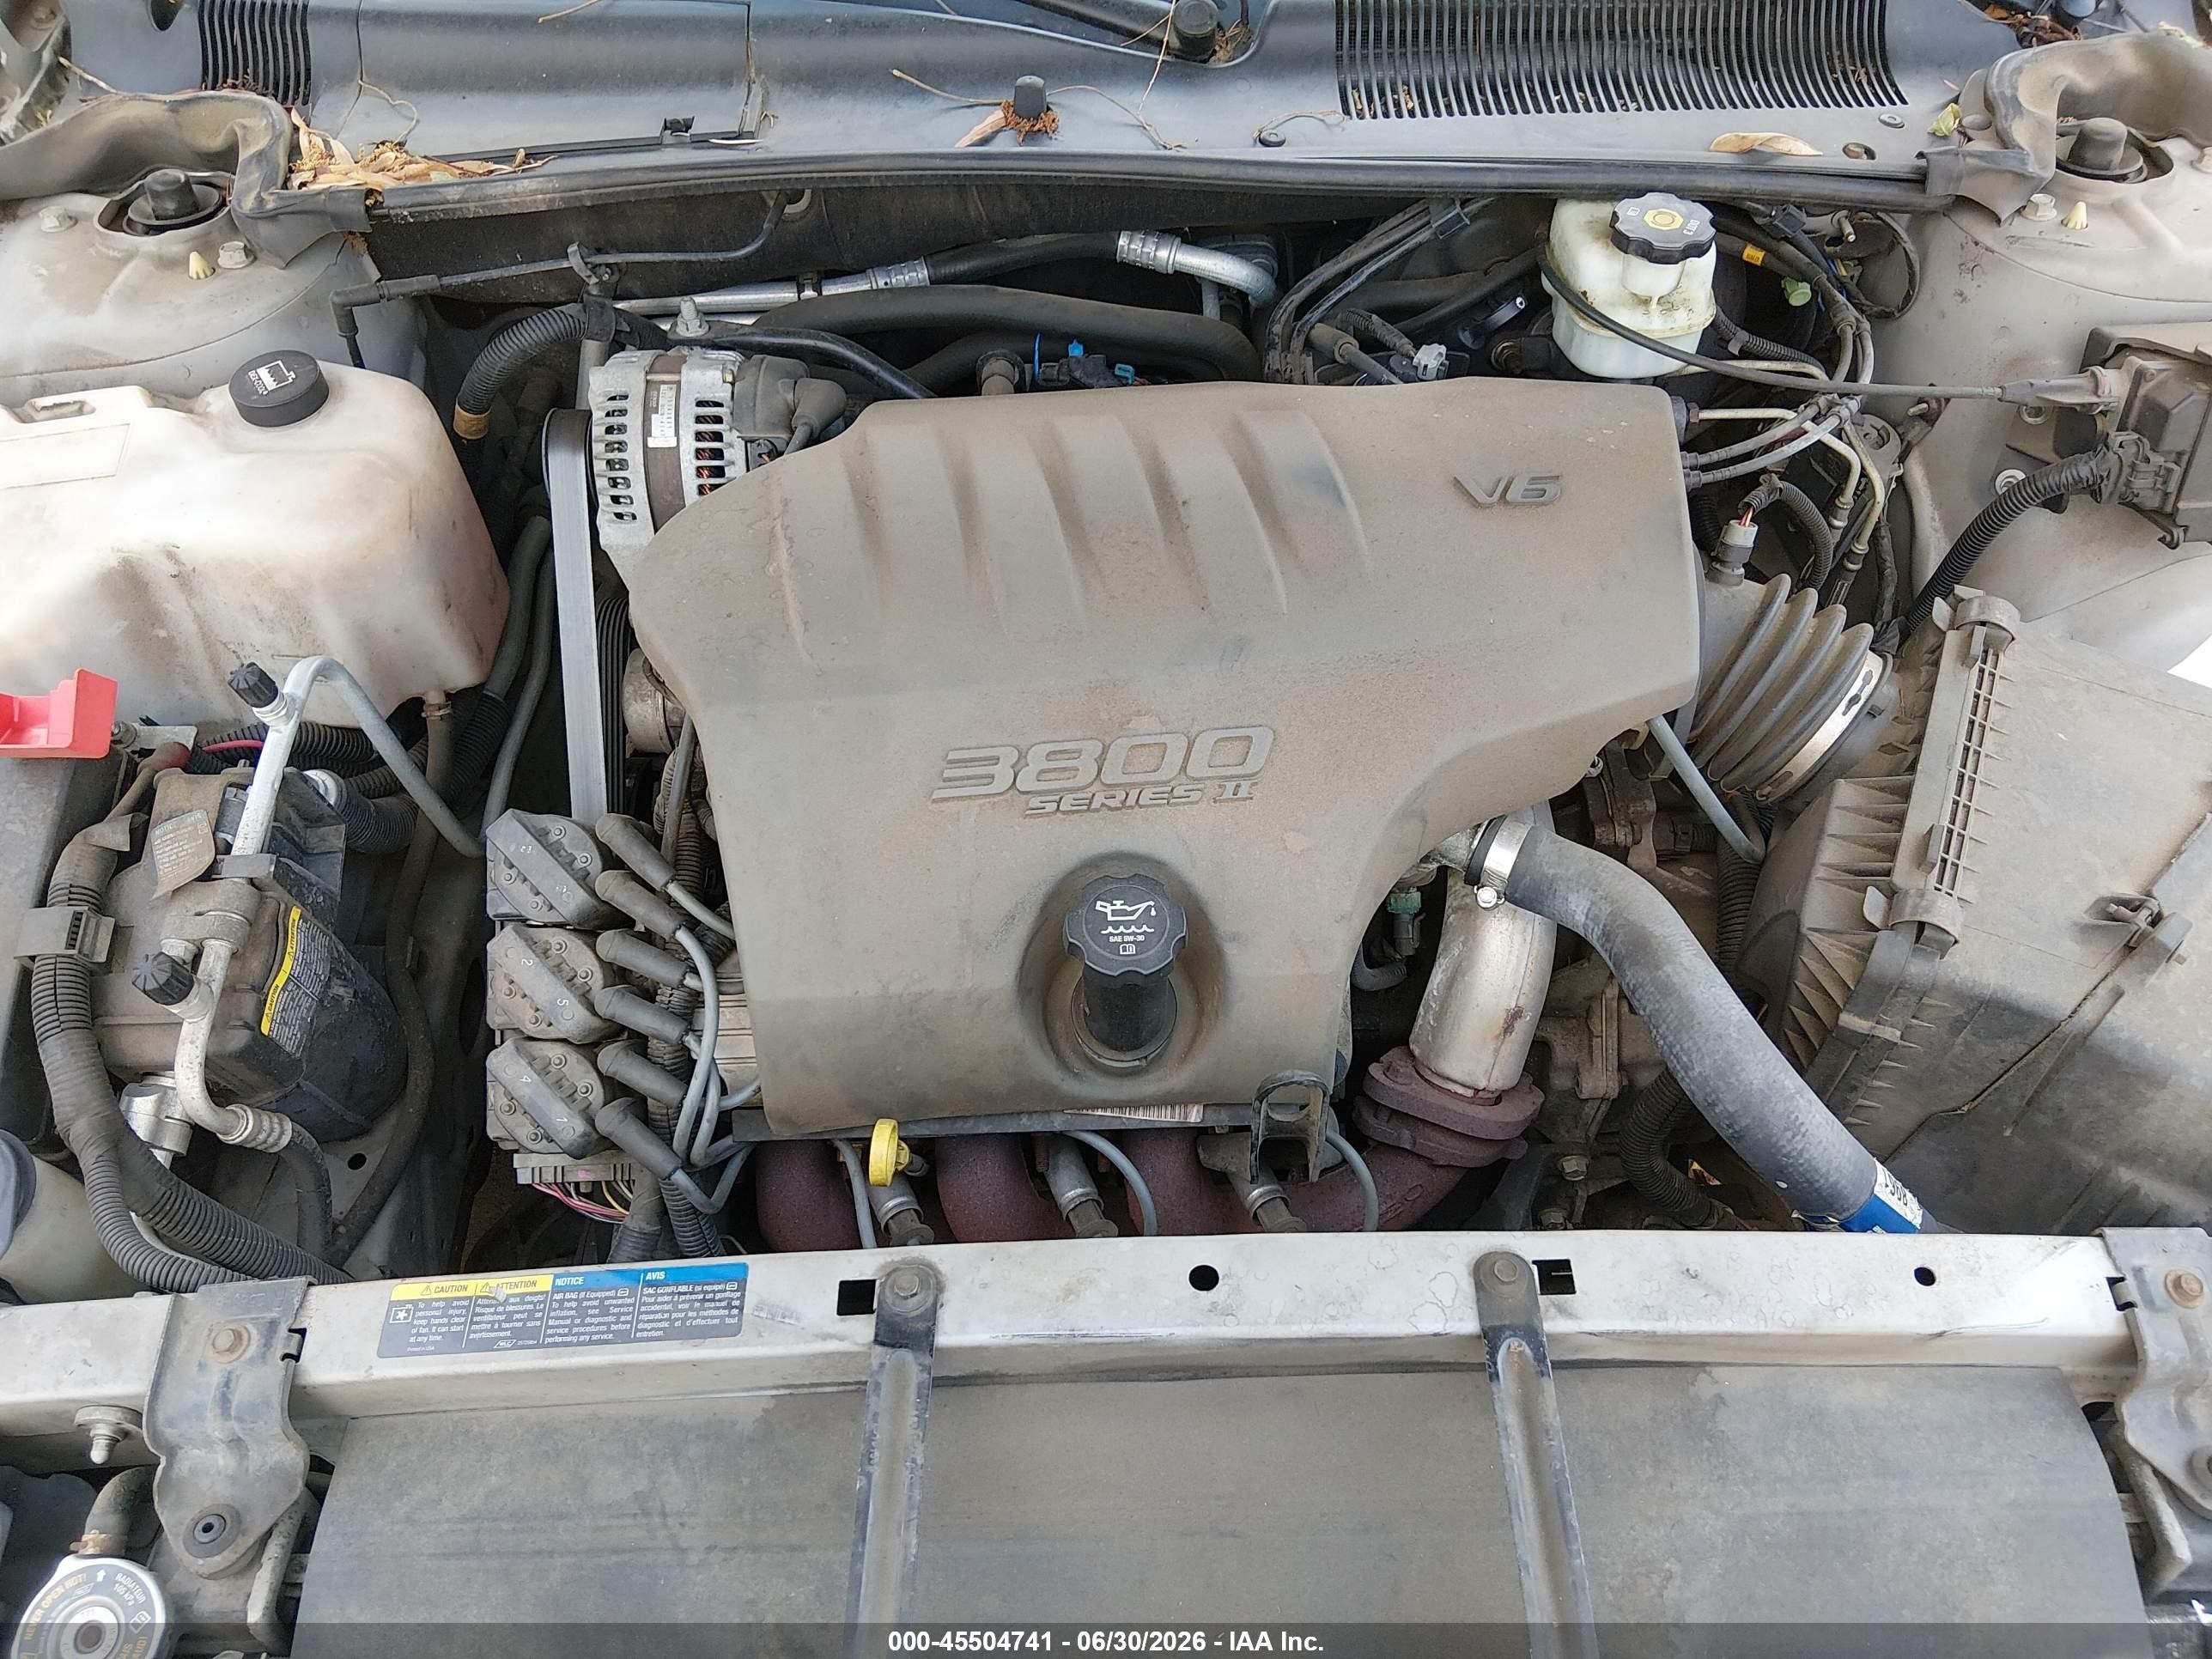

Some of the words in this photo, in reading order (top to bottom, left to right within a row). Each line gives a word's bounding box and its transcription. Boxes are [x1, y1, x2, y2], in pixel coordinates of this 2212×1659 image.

[1453, 474, 1562, 506] V6
[932, 726, 1274, 802] 3800
[1024, 784, 1204, 818] SERIES
[1123, 934, 1146, 943] 5W-30
[556, 998, 569, 1006] 5
[645, 1271, 665, 1280] AVIS
[555, 1277, 585, 1286] NOTICE
[434, 1285, 468, 1294] CAUTION
[586, 1290, 617, 1298] Equipped)
[657, 1285, 694, 1294] GONFLABLE
[714, 1291, 741, 1300] gonflage
[605, 1297, 635, 1305] unwanted
[513, 1311, 528, 1320] peut
[585, 1316, 617, 1324] diagnostic
[671, 1311, 687, 1320] pour
[573, 1325, 607, 1334] procedures
[637, 1321, 670, 1330] diagnostic
[544, 1336, 578, 1345] performing
[114, 1572, 147, 1604] RADIATEUR
[23, 1607, 43, 1641] NEVER
[40, 1584, 65, 1610] OPEN
[64, 1572, 88, 1590] HOT!
